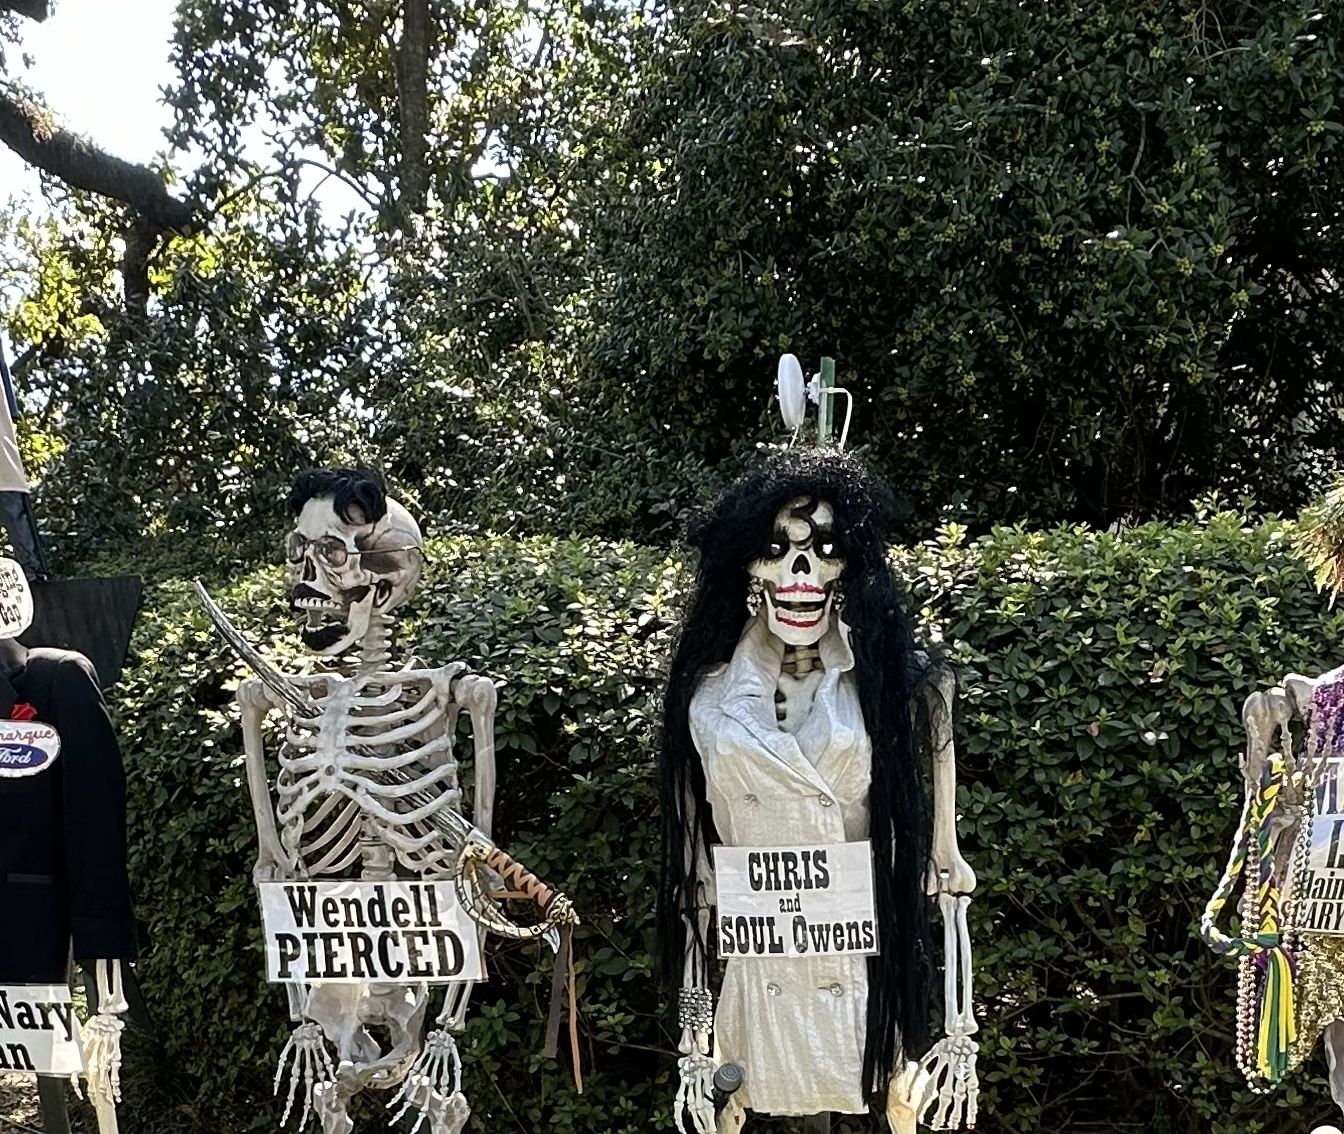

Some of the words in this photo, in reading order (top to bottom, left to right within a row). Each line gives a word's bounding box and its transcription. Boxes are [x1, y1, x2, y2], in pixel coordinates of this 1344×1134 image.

[748, 849, 830, 892] CHRIS
[283, 884, 442, 928] Wendell
[778, 893, 802, 913] and
[274, 929, 466, 979] PIERCED
[721, 915, 785, 955] SOUL
[792, 915, 875, 954] Owens
